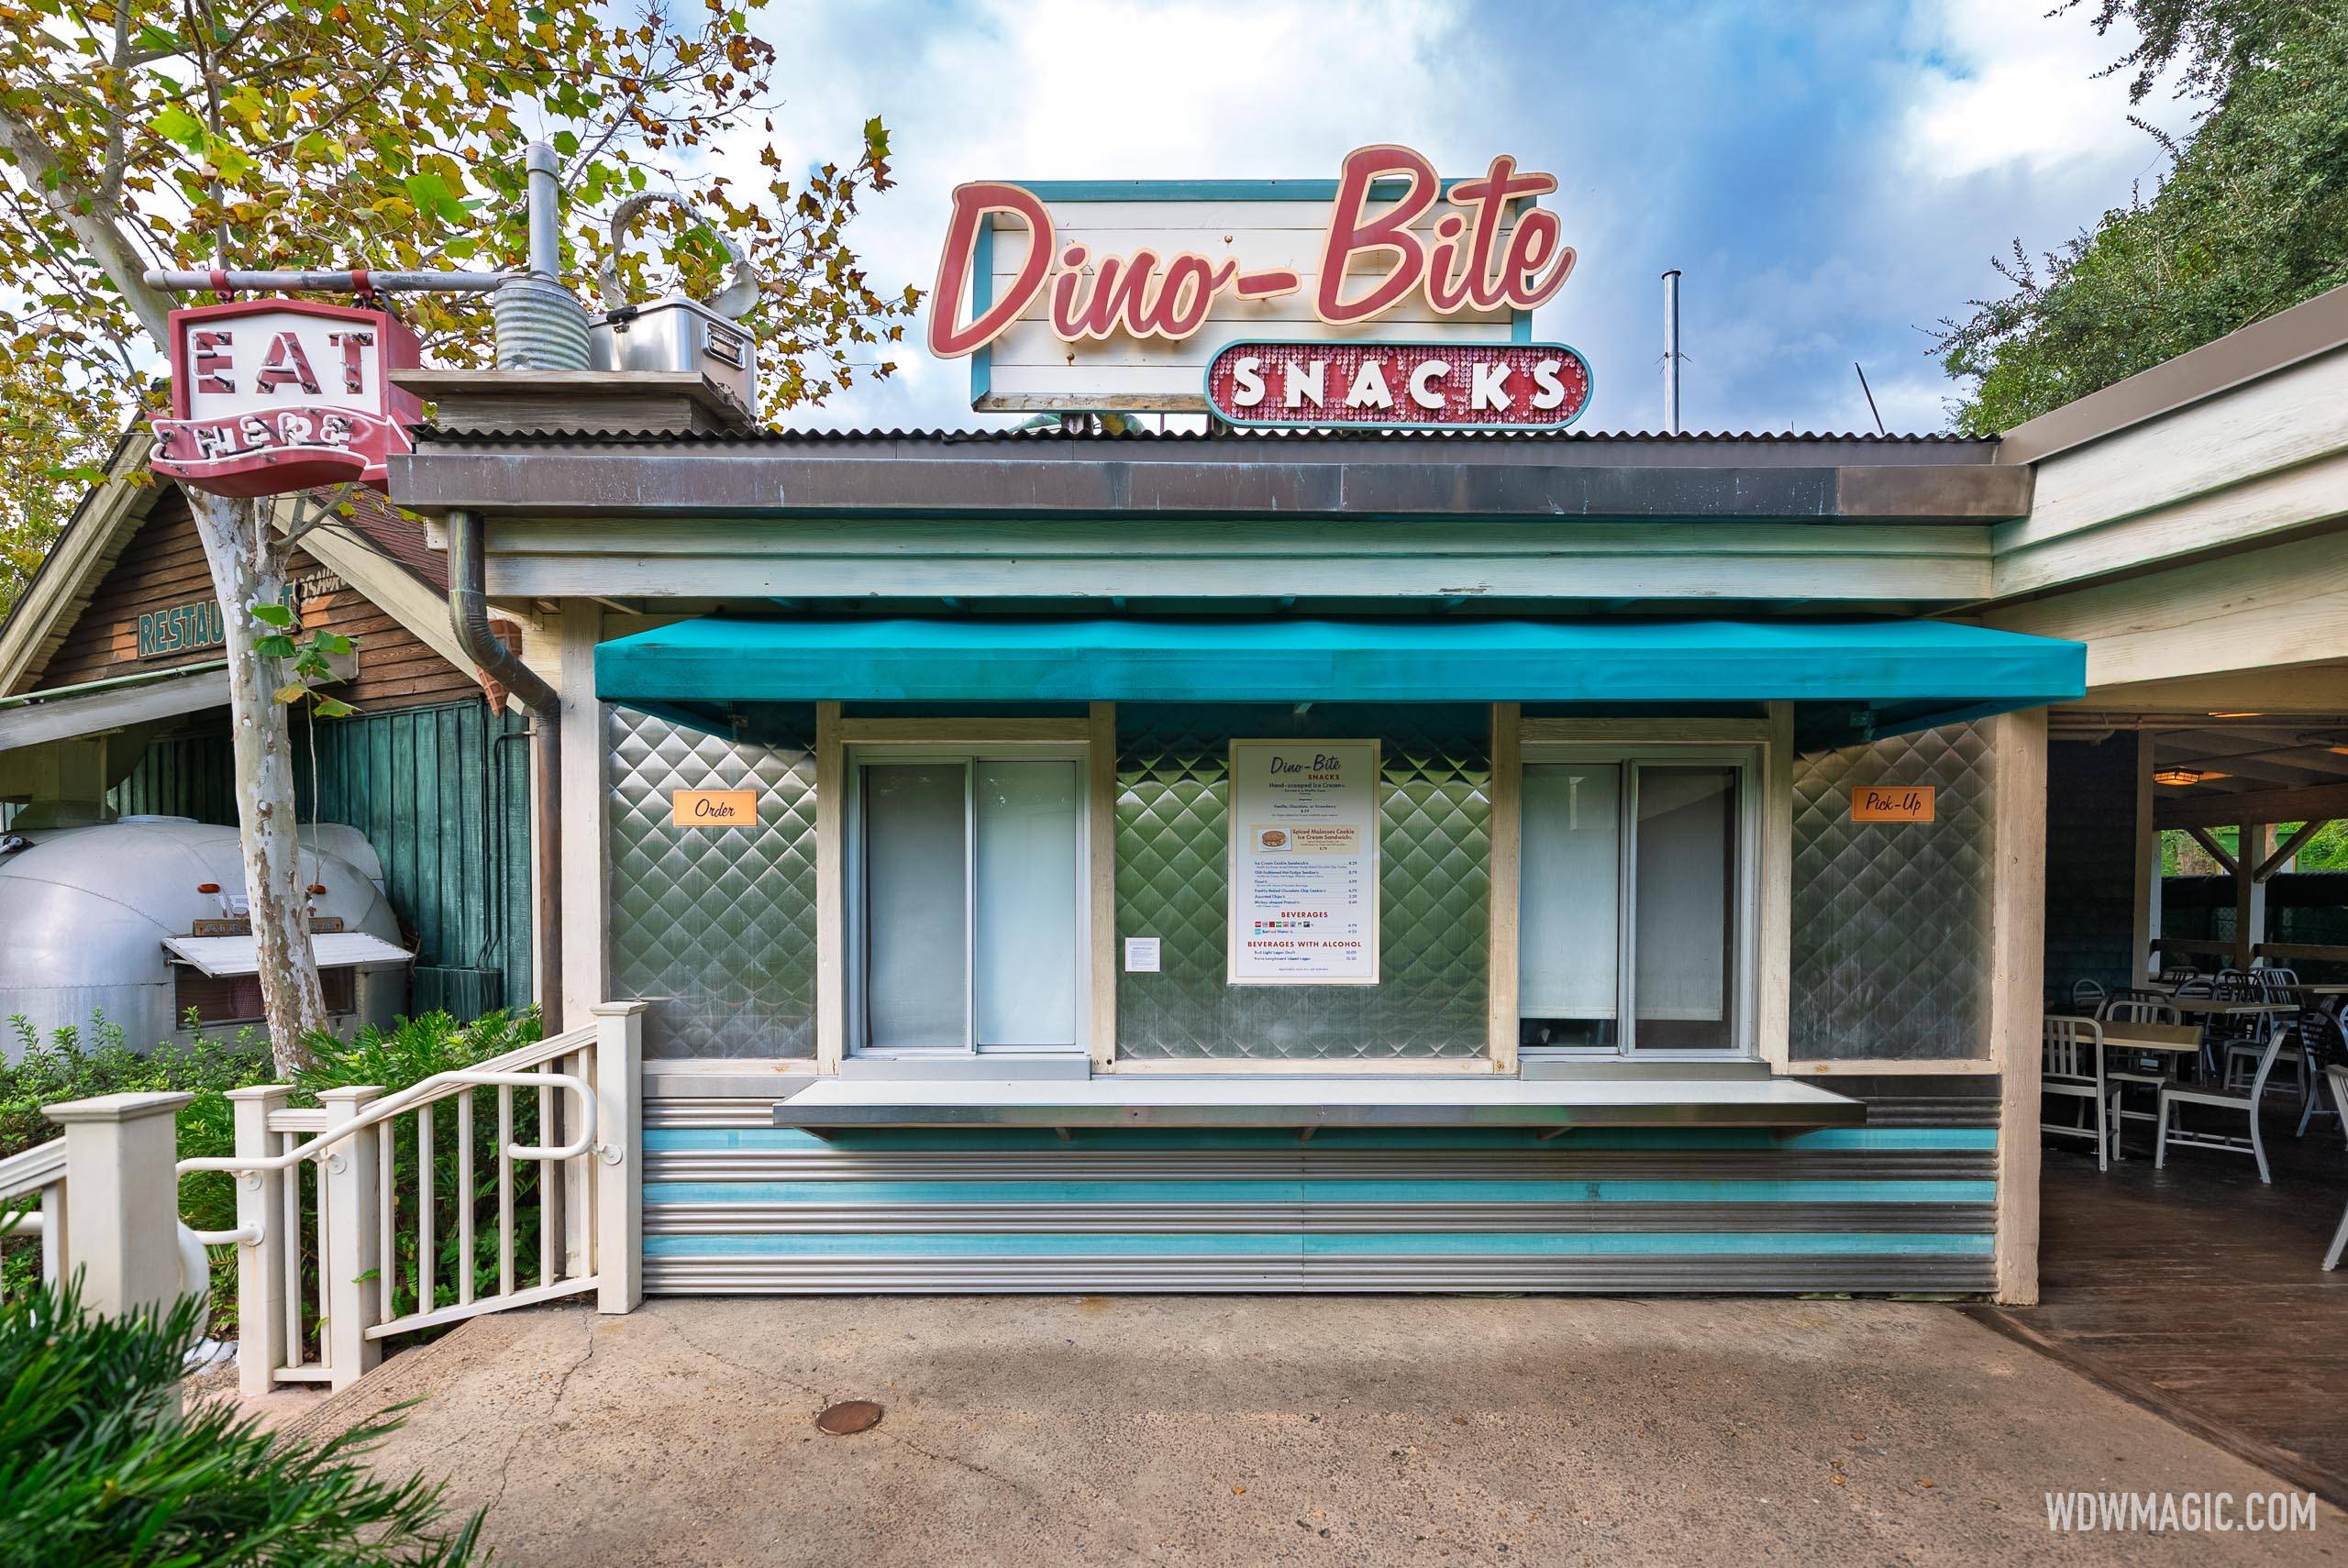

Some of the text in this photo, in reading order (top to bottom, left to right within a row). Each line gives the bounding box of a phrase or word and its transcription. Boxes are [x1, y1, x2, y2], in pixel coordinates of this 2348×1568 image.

[927, 144, 1577, 359] Dino-Bite
[190, 328, 374, 394] EAT
[1233, 357, 1566, 413] SNACKS
[193, 413, 354, 465] HERE
[139, 581, 296, 658] RESTAUT
[1270, 754, 1342, 774] Dino-Bite
[694, 799, 736, 817] Order
[1866, 792, 1922, 816] Pick-Up
